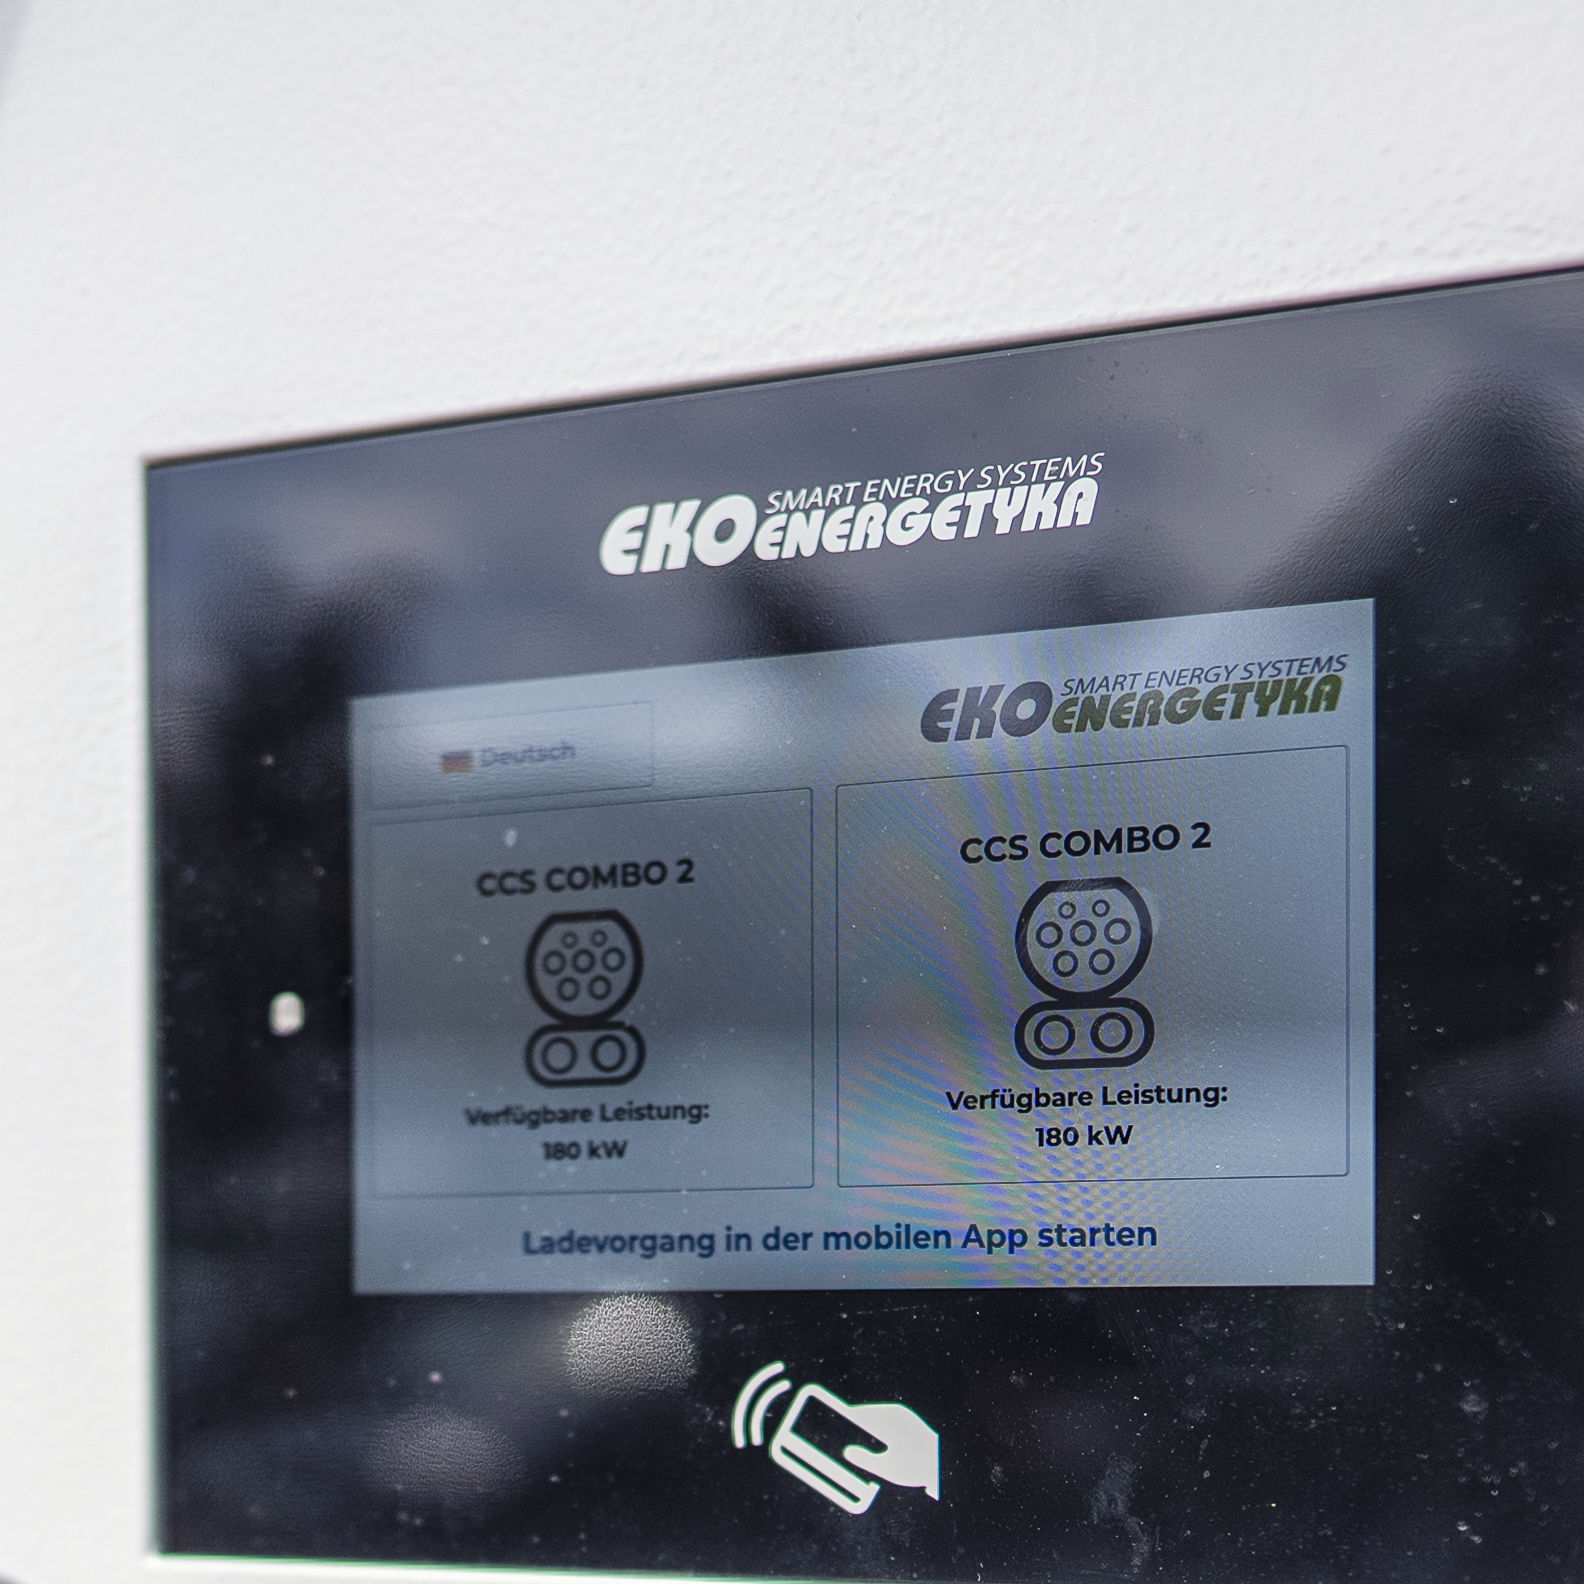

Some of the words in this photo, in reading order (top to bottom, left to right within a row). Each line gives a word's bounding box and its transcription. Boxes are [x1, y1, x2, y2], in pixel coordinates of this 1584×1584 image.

[764, 481, 862, 515] SMART
[863, 468, 974, 503] ENERGY
[976, 452, 1106, 489] SYSTEMS
[1061, 672, 1142, 697] SMART
[1144, 663, 1240, 690] ENERGY
[1240, 654, 1350, 681] SYSTEMS
[479, 741, 577, 768] Deutsch
[959, 833, 1029, 864] CCS
[1037, 824, 1181, 860] COMBO
[1191, 821, 1213, 850] 2
[476, 869, 538, 898] CCS
[544, 860, 669, 893] COMBO
[675, 858, 696, 885] 2
[465, 1103, 593, 1130] Verfügbare
[600, 1100, 710, 1125] Leistung:
[945, 1086, 1094, 1114] Verfügbare
[1101, 1082, 1229, 1110] Leistung:
[542, 1141, 581, 1161] 180
[588, 1139, 628, 1160] kW
[1035, 1126, 1080, 1147] 180
[1087, 1124, 1134, 1146] kW
[522, 1227, 716, 1259] Ladevorgang
[724, 1225, 753, 1253] in
[761, 1225, 814, 1252] der
[822, 1222, 953, 1252] mobilen
[961, 1222, 1028, 1255] App
[1037, 1221, 1159, 1249] starten
